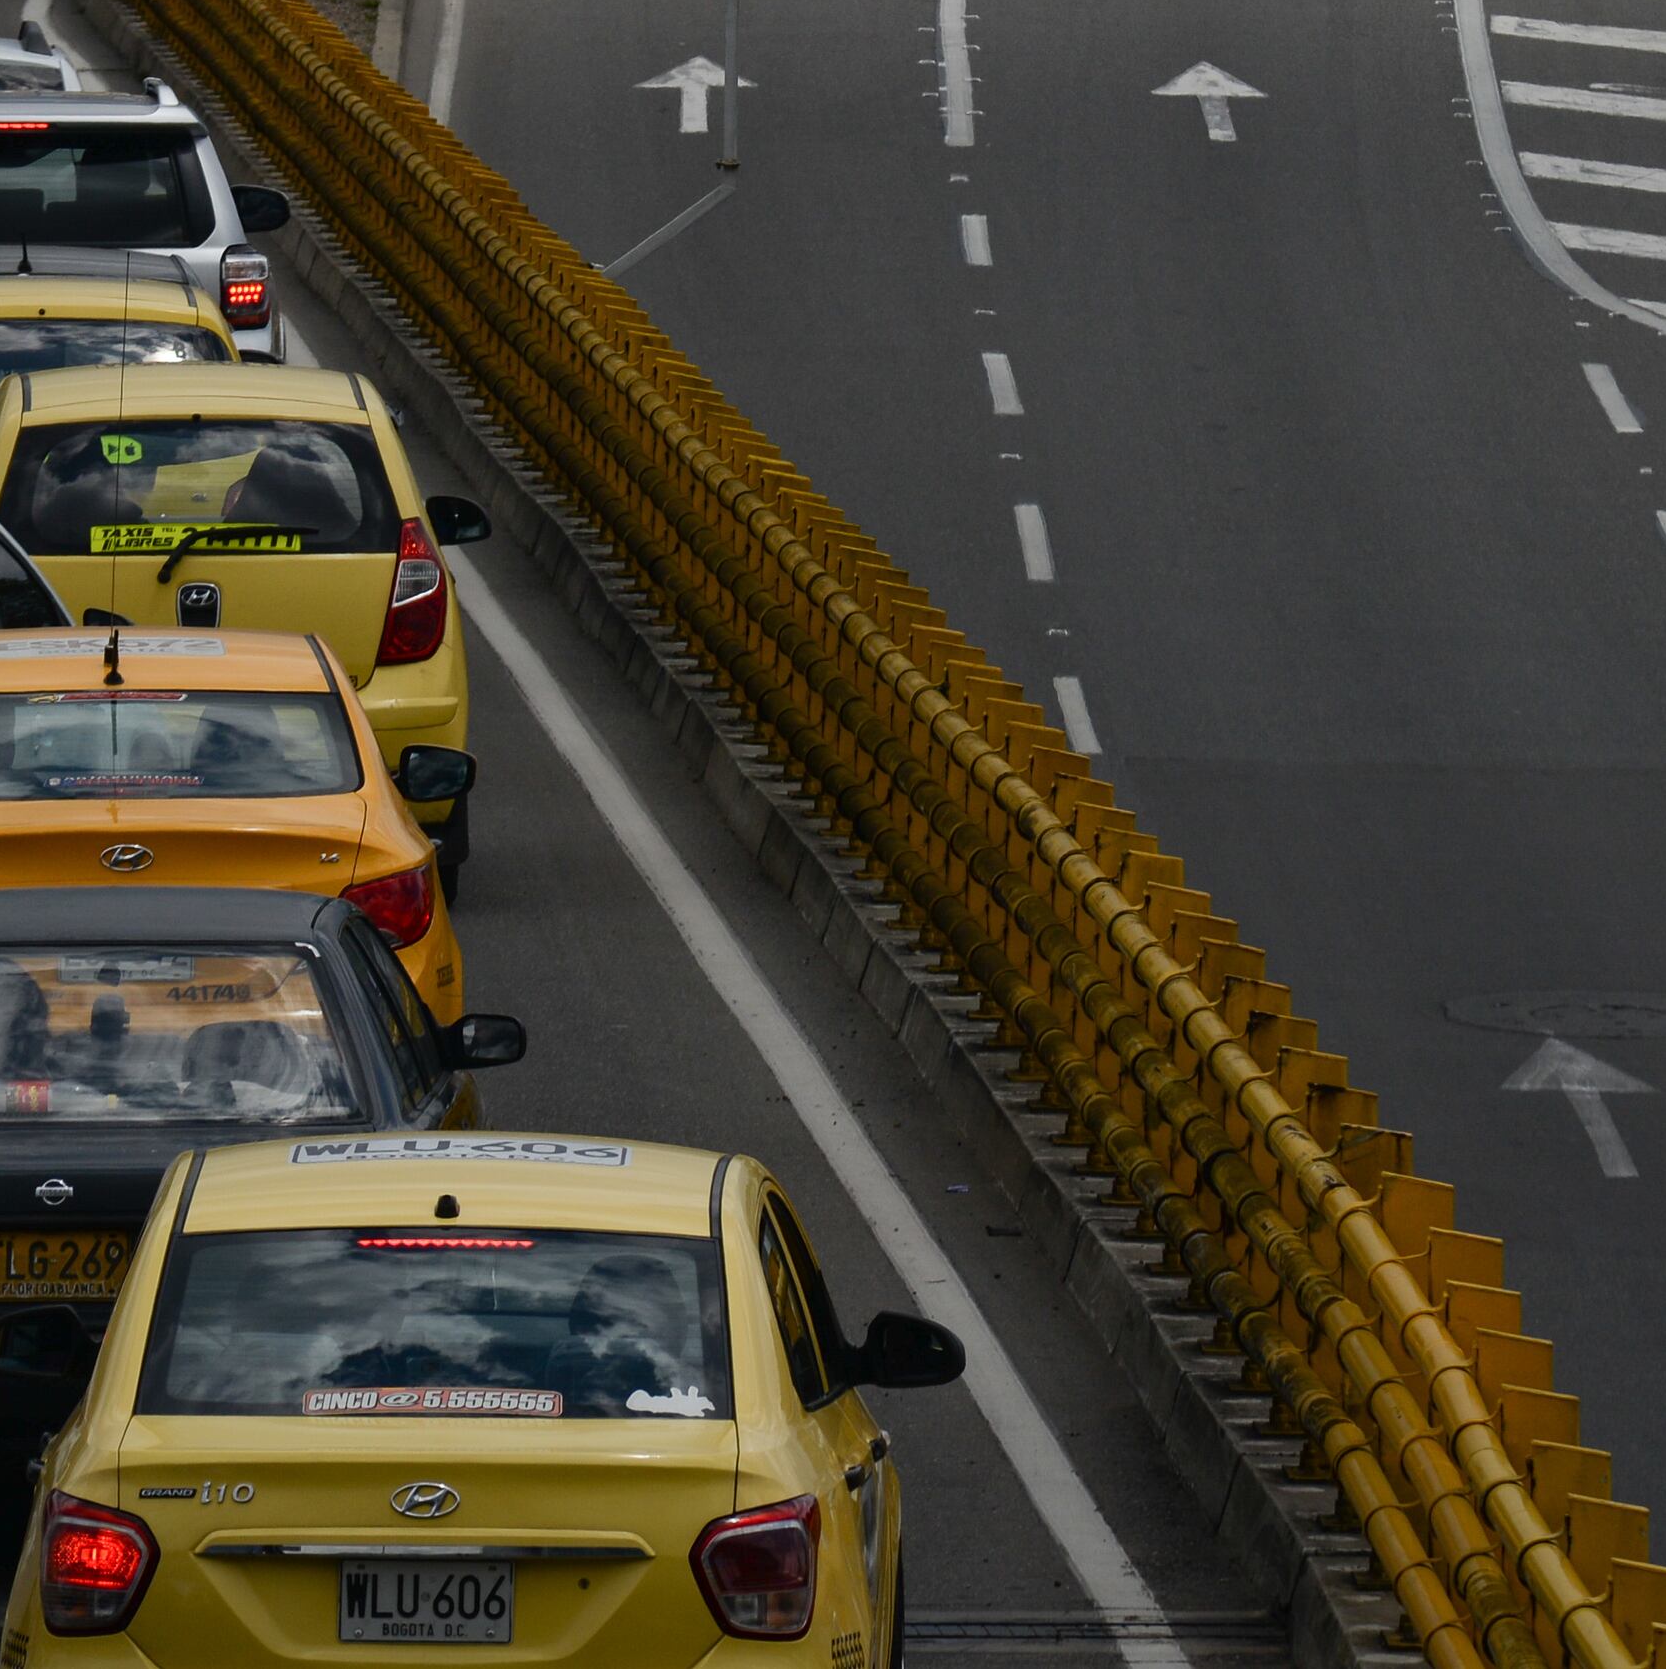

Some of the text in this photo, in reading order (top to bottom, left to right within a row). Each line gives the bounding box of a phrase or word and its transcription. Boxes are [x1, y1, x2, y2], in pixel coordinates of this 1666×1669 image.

[102, 527, 154, 538] TAXIS
[116, 537, 174, 548] LIBRES
[309, 1390, 376, 1411] CINCO
[141, 1480, 255, 1505] GRAND i10
[346, 1573, 506, 1620] WLU 606
[382, 1623, 435, 1638] BOGOTA
